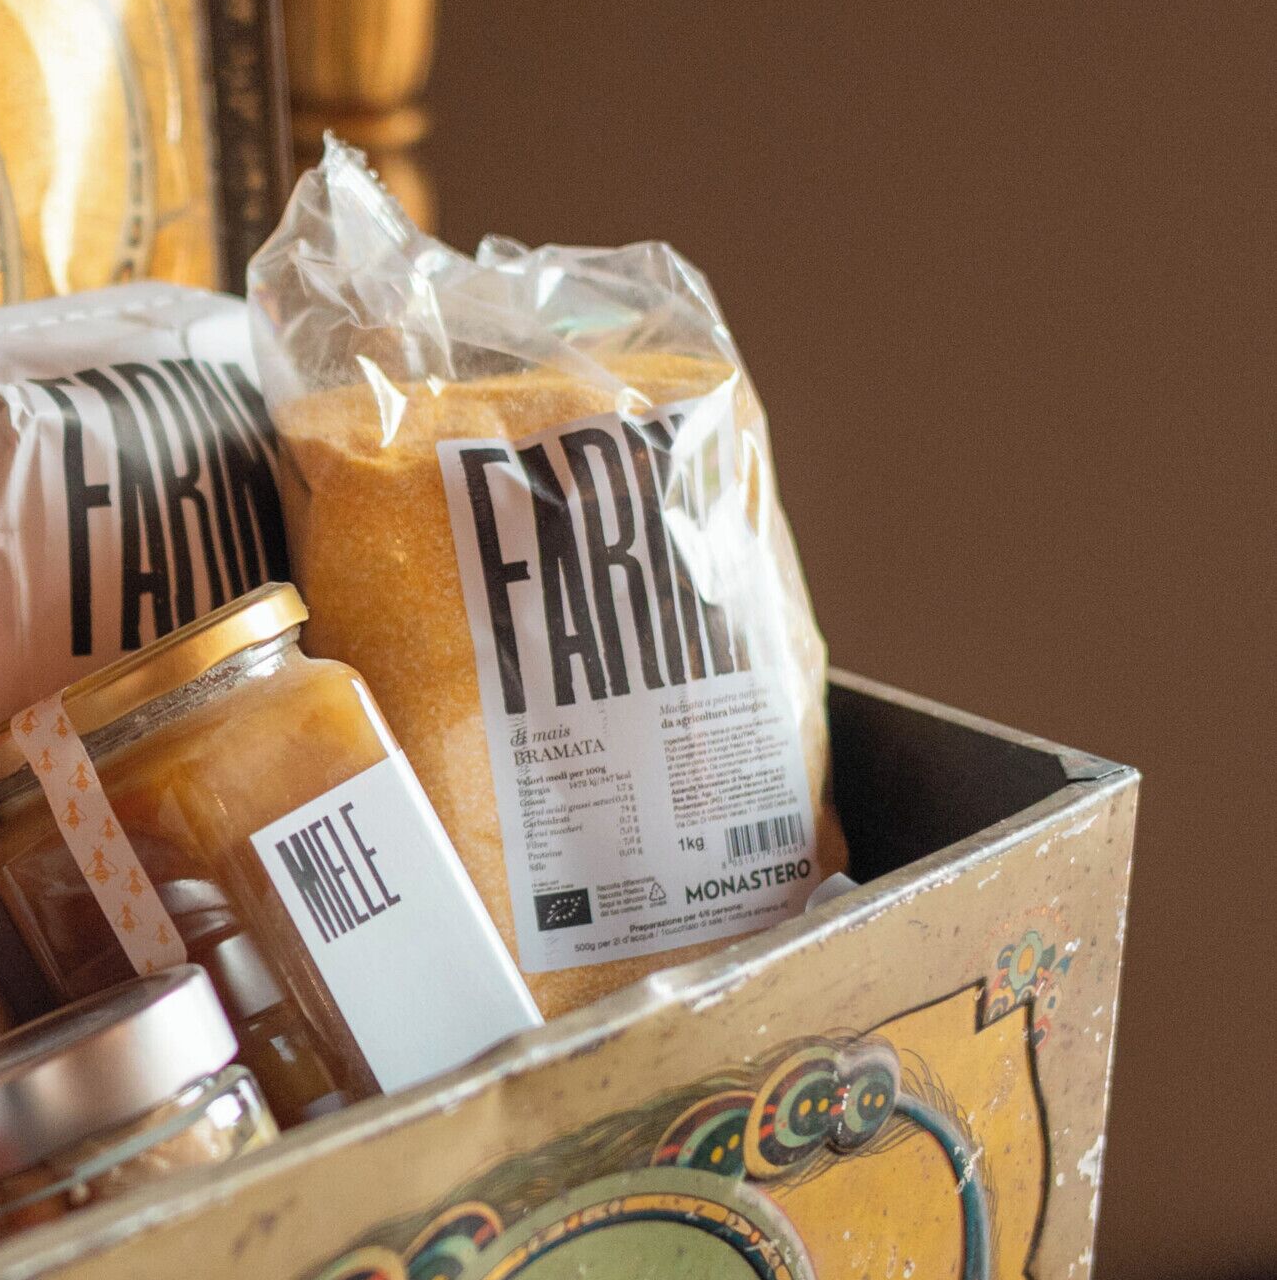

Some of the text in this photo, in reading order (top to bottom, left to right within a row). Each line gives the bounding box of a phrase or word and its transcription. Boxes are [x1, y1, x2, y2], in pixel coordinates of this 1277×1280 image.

[25, 357, 297, 657] FARIN
[458, 412, 753, 715] FARIN
[532, 724, 571, 743] mais
[661, 719, 674, 729] da
[514, 738, 605, 767] BRAMATA
[569, 769, 584, 781] per
[678, 836, 705, 852] 1kg
[274, 801, 402, 944] MIELE
[684, 858, 811, 905] MONASTERO
[629, 916, 683, 933] Preparazione
[683, 910, 696, 923] per
[574, 941, 596, 954] 500g
[597, 938, 611, 951] per
